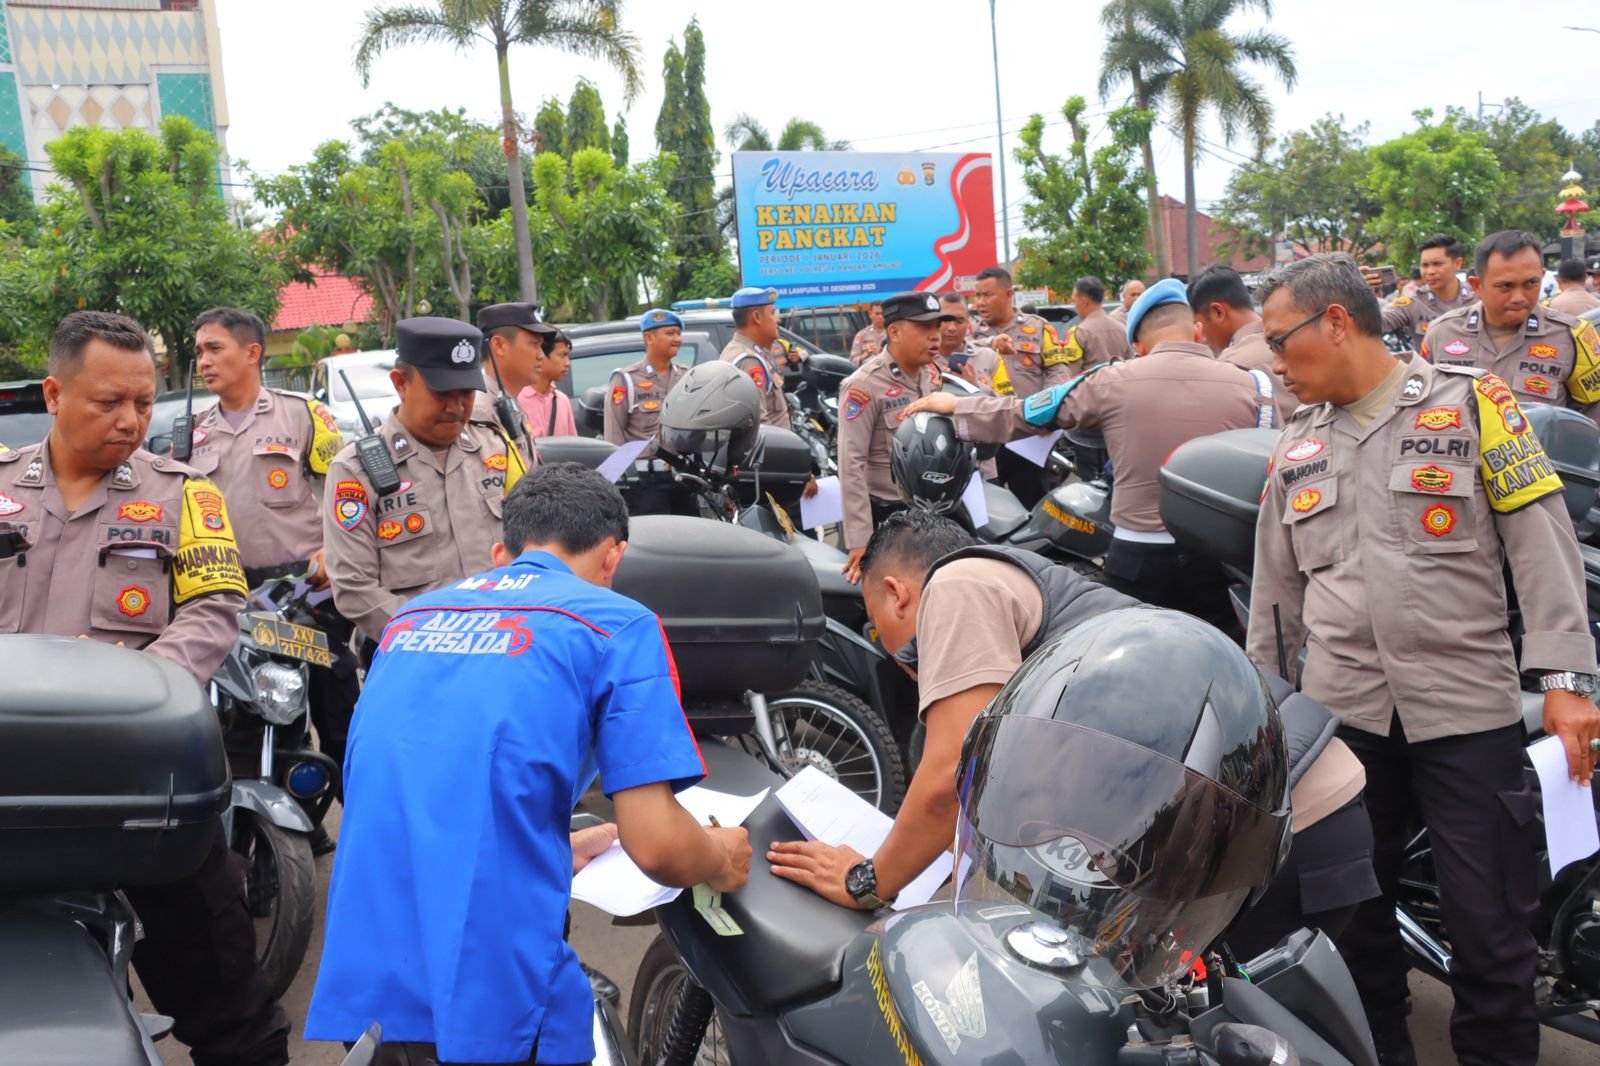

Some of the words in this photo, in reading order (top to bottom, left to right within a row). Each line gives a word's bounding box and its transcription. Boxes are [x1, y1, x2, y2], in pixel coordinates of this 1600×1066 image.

[761, 157, 878, 199] Upacara
[756, 202, 897, 226] KENAIKAN
[757, 226, 886, 250] PANGKAT
[760, 253, 801, 264] PERIODE
[814, 251, 852, 262] JANUARI
[1519, 361, 1561, 377] POLRI
[256, 436, 298, 446] POLRI
[1400, 438, 1470, 457] POLRI
[1482, 432, 1543, 474] BHAB
[1487, 454, 1555, 500] KAMTIB
[107, 527, 170, 545] POLRI
[455, 574, 535, 591] Mobil
[419, 612, 501, 632] AUTO
[290, 625, 315, 645] XXV
[387, 630, 512, 655] PERSADA
[913, 981, 960, 1055] HONDA
